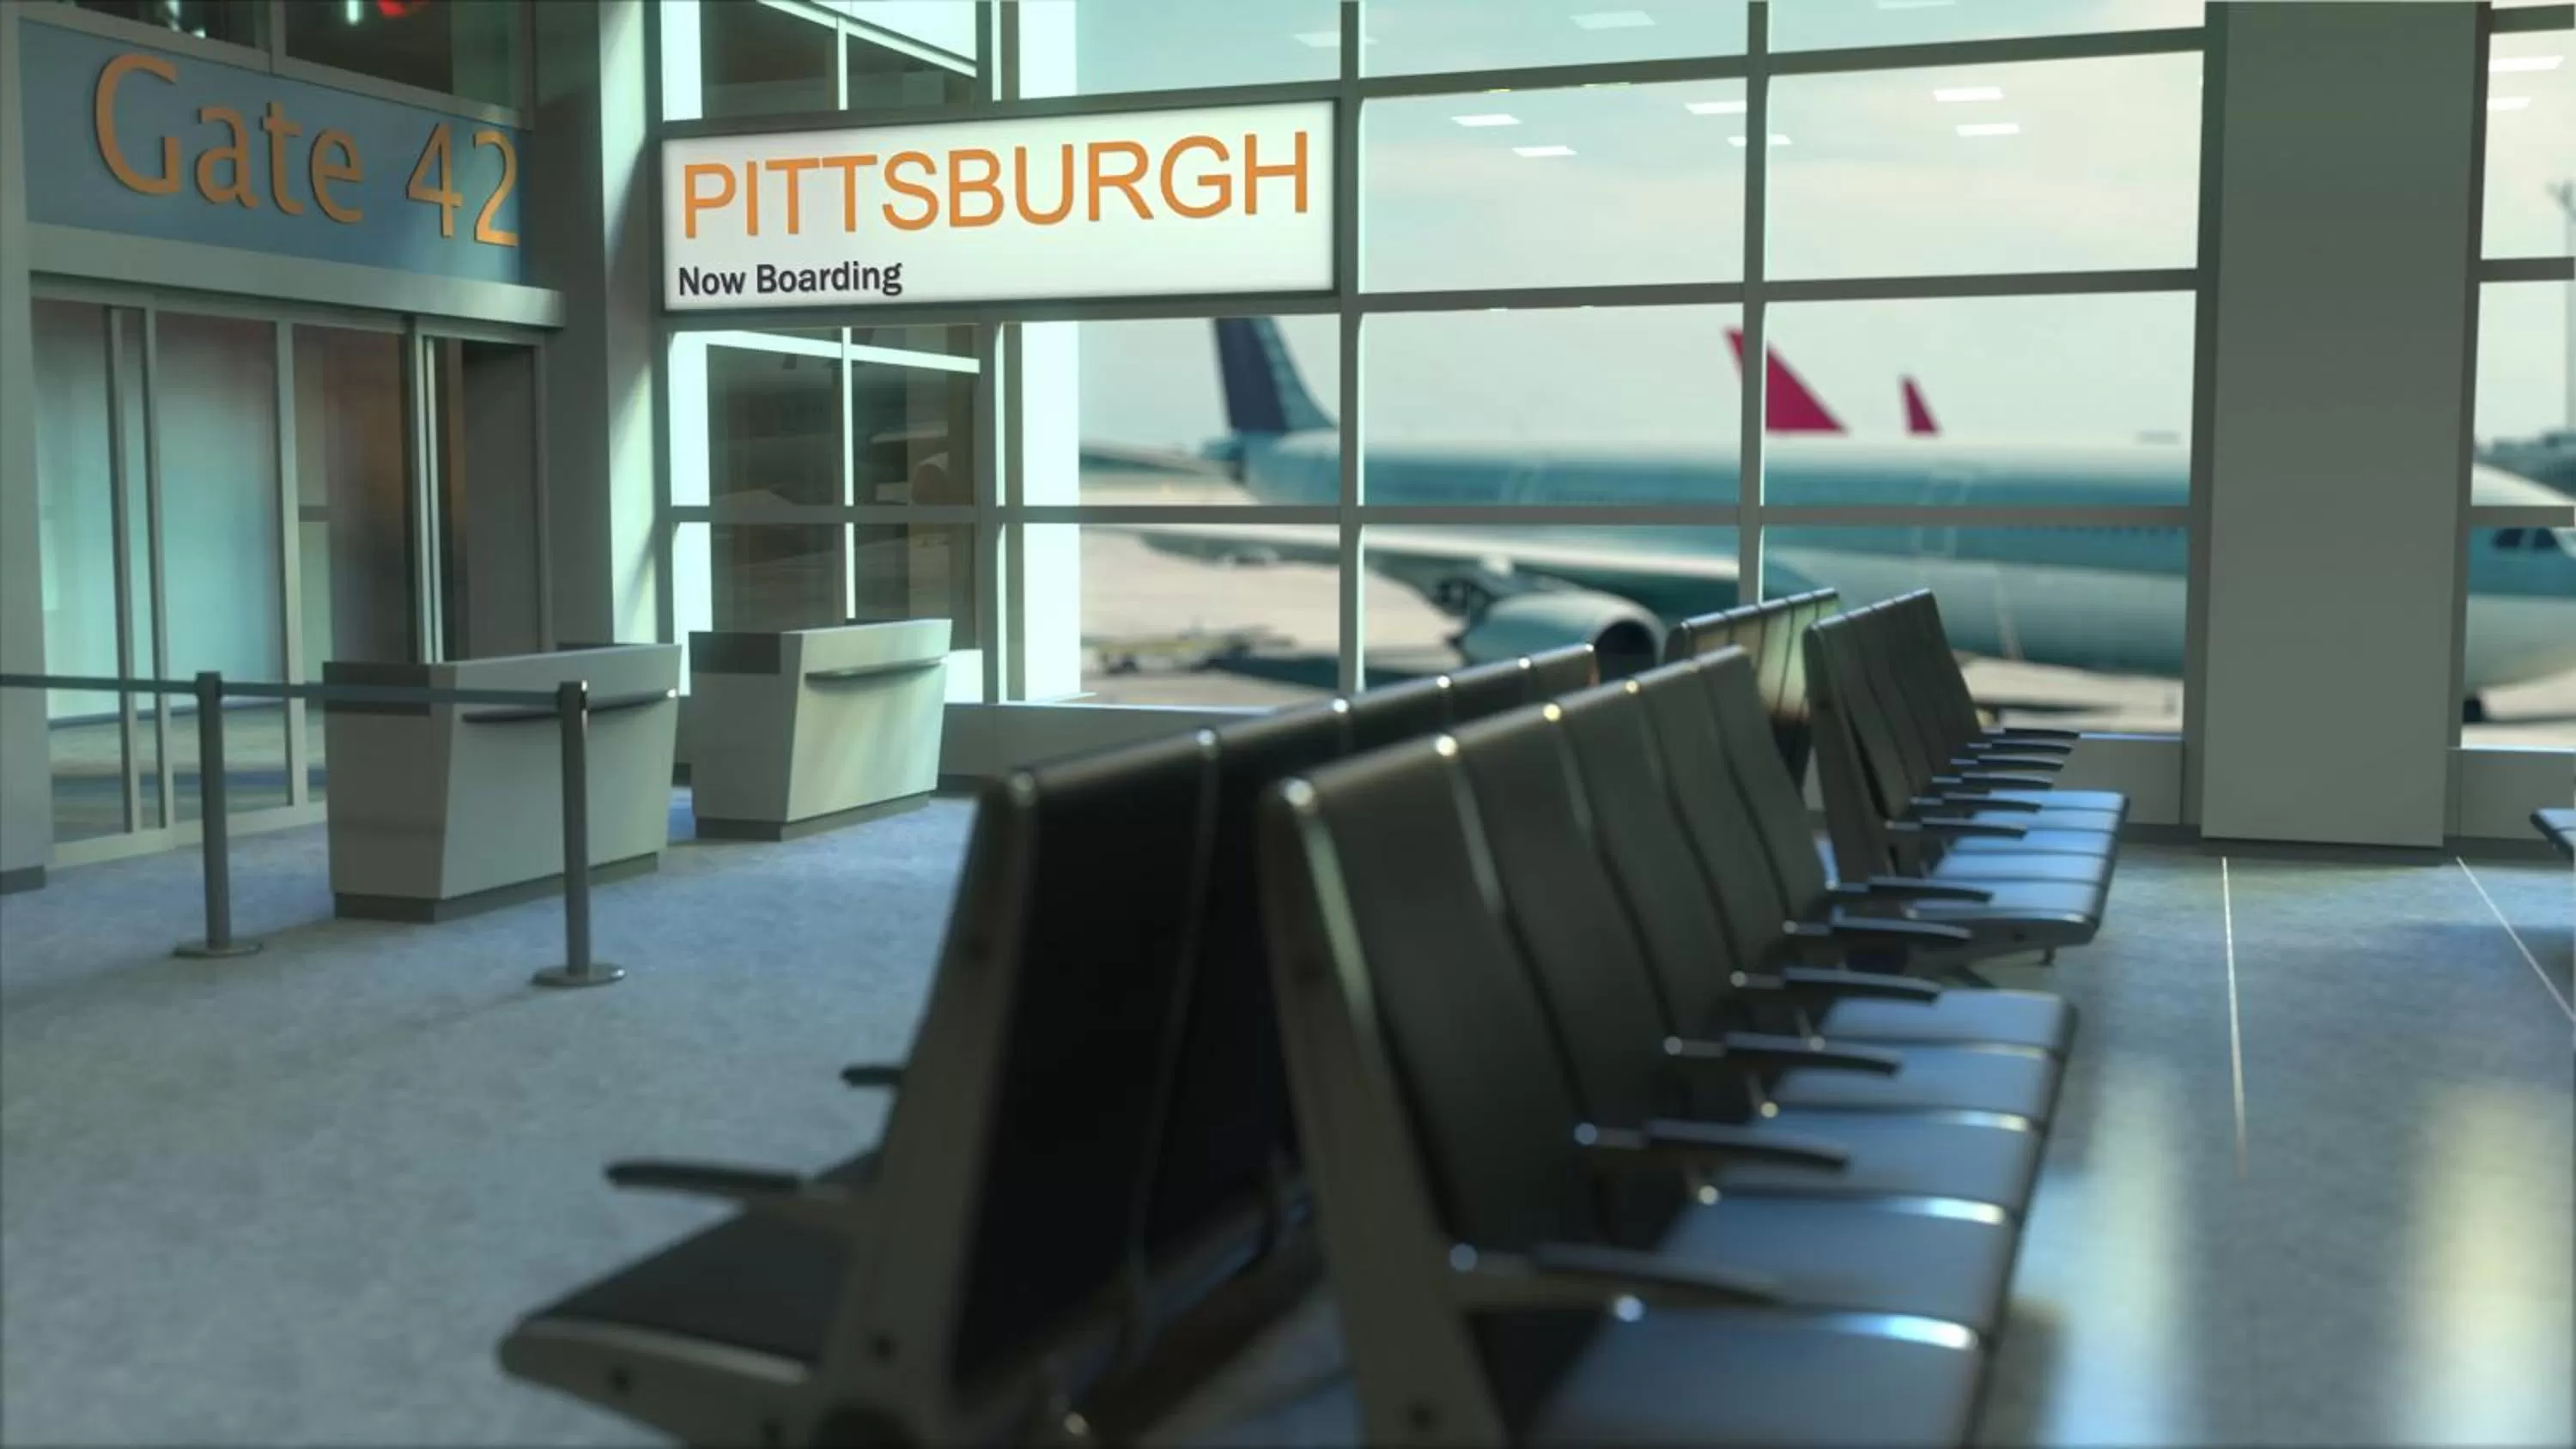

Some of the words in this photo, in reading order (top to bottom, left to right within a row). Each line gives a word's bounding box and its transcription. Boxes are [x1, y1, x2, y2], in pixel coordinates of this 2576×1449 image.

[94, 52, 364, 224] Gate
[406, 122, 520, 247] 42
[683, 130, 1309, 239] PITTSBURGH
[678, 265, 746, 296] Now
[756, 261, 902, 297] Boarding
